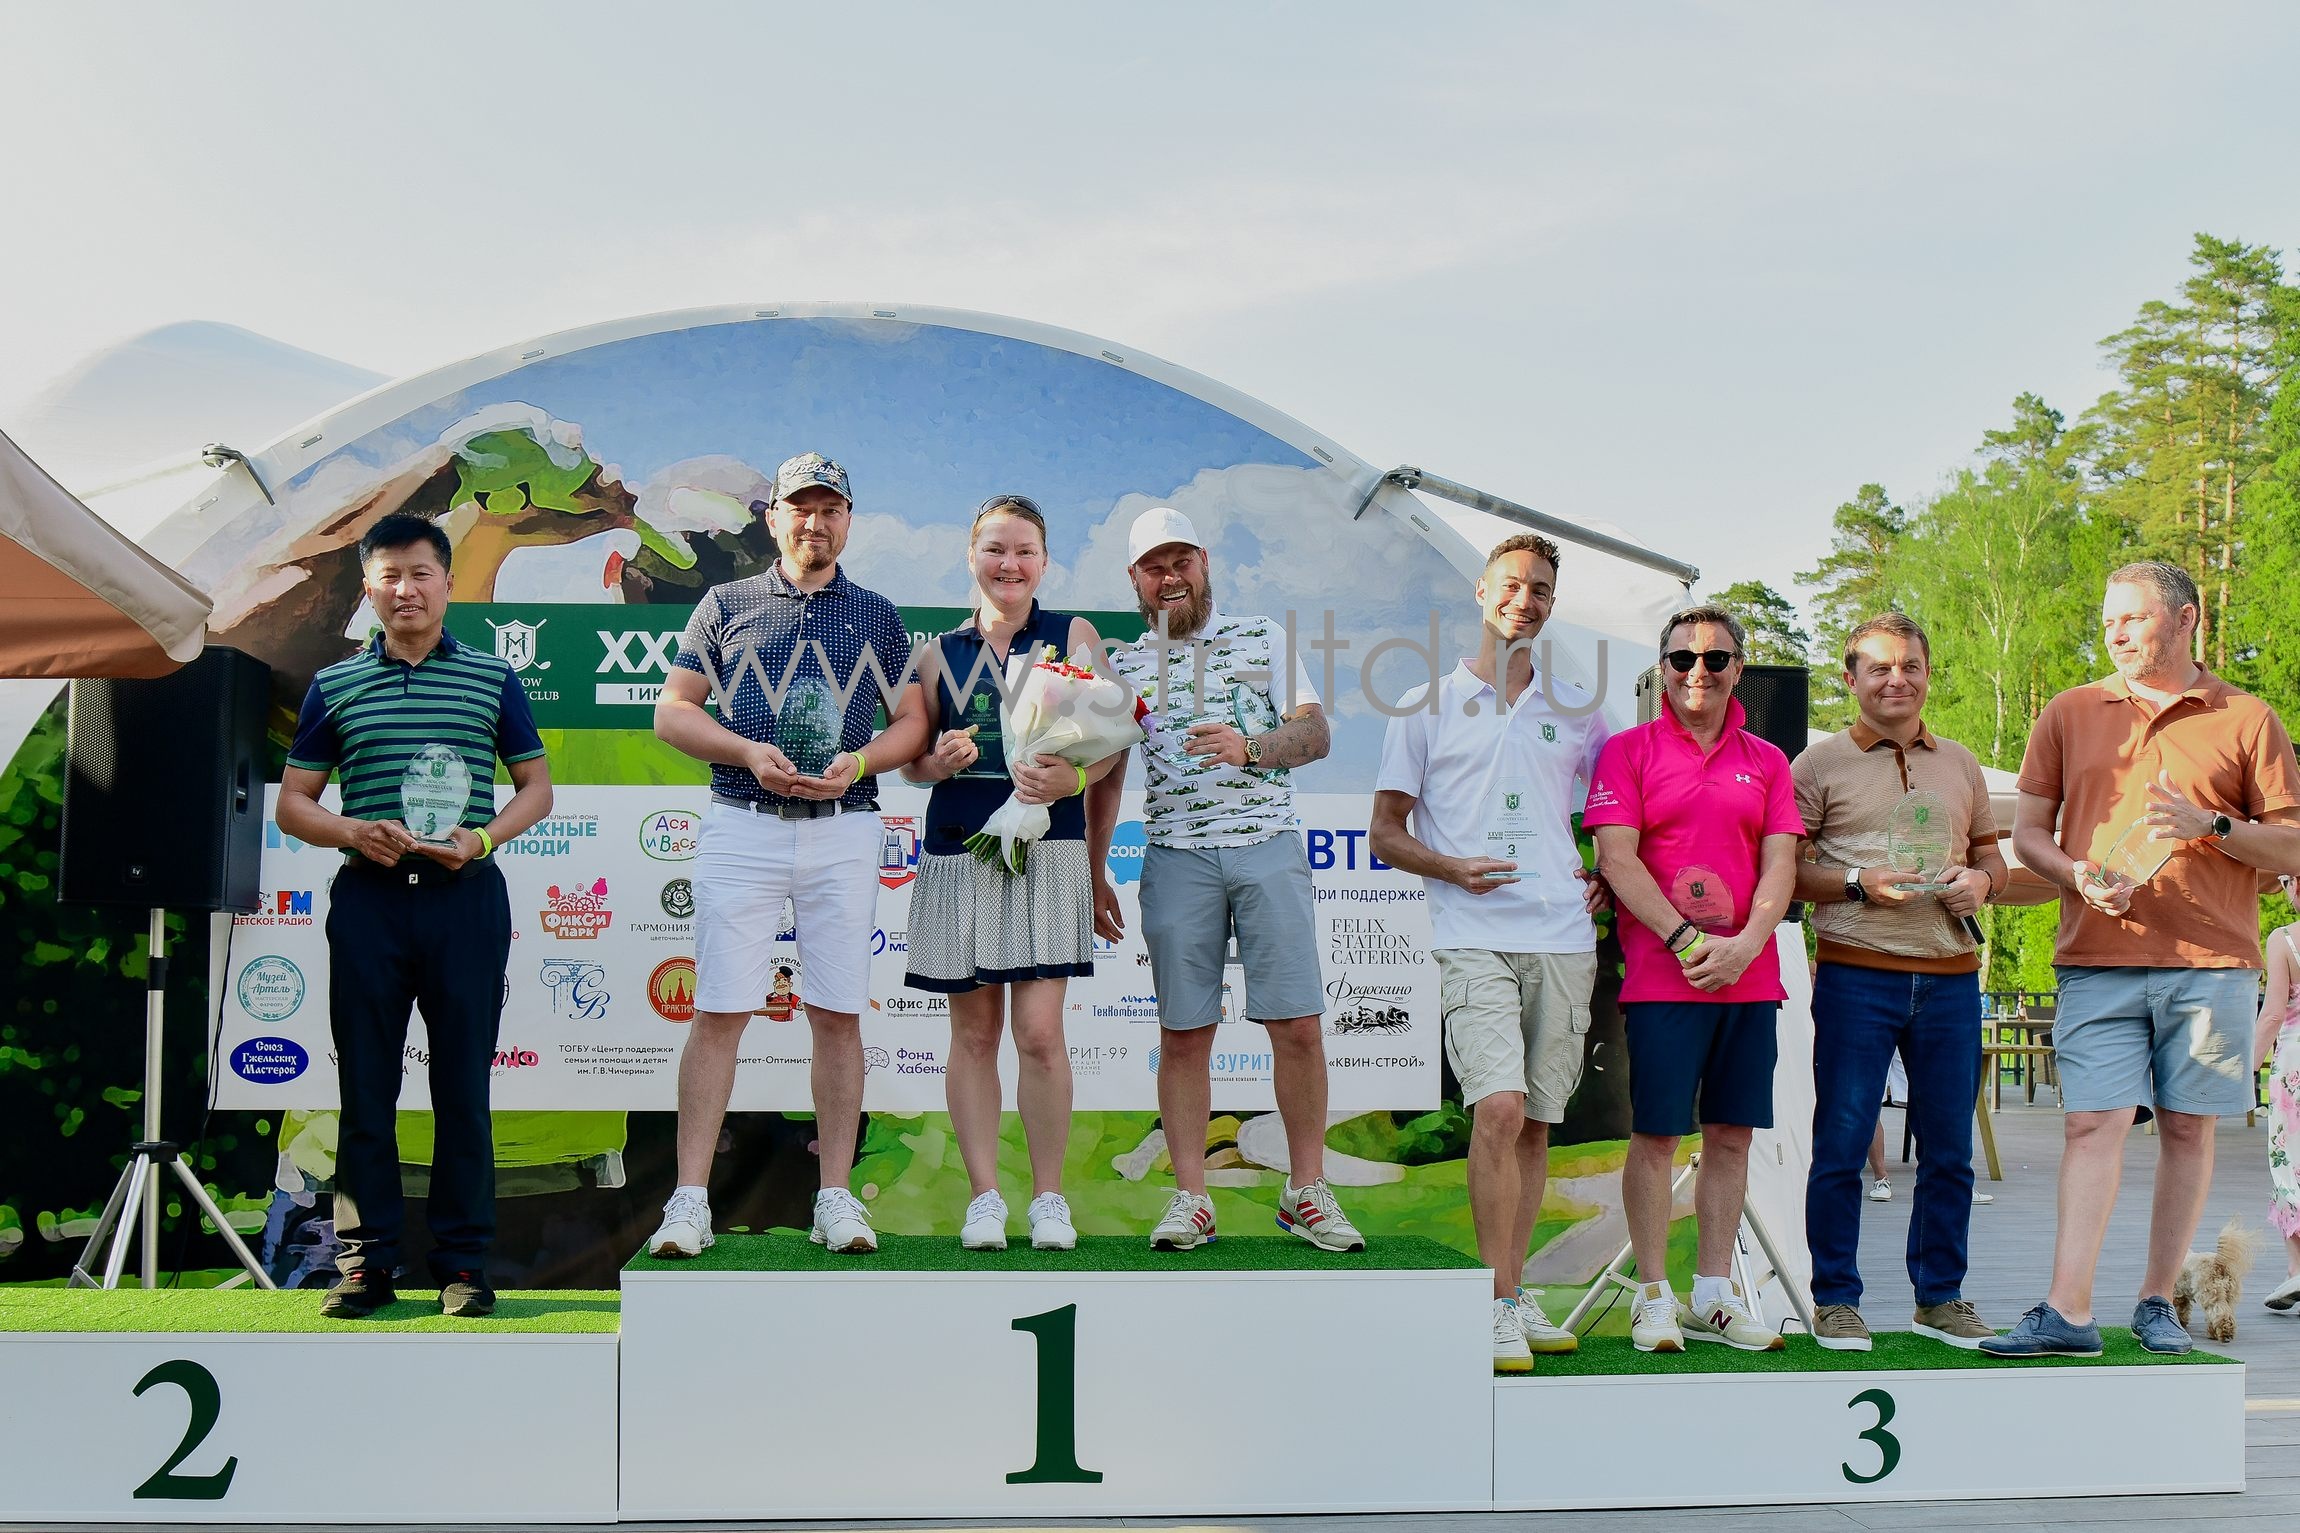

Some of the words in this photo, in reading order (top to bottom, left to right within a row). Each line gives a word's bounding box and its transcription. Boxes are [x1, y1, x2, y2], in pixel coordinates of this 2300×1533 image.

[595, 631, 683, 673] XX
[529, 691, 560, 701] CLUB
[655, 815, 689, 831] Ася
[505, 839, 570, 857] ЛЮДИ
[1508, 844, 1516, 855] 3
[1341, 889, 1425, 903] поддержке
[278, 917, 313, 927] РАДИО
[630, 923, 690, 932] ГАРМОНИЯ
[1331, 918, 1386, 933] FELIX
[1331, 934, 1411, 949] STATION
[1331, 950, 1425, 965] CATERING
[256, 971, 288, 984] Музей
[251, 983, 291, 996] Артель
[1326, 971, 1412, 1008] Федоскино
[887, 997, 923, 1012] Офис
[927, 998, 947, 1011] ДК
[255, 1040, 284, 1052] Союз
[559, 1044, 590, 1053] ТОГБУ
[591, 1045, 623, 1054] «Центр
[625, 1046, 674, 1054] поддержки
[242, 1052, 297, 1066] Гжельских
[599, 1057, 634, 1065] помощи
[642, 1057, 668, 1065] детям
[897, 1047, 935, 1061] Фонд
[1329, 1056, 1425, 1068] «КВИН-СТРОЙ»
[242, 1063, 296, 1077] Мастеров
[1709, 1309, 1733, 1331] N
[1006, 1303, 1103, 1484] 1
[133, 1360, 238, 1500] 2
[1842, 1389, 1901, 1484] 3
